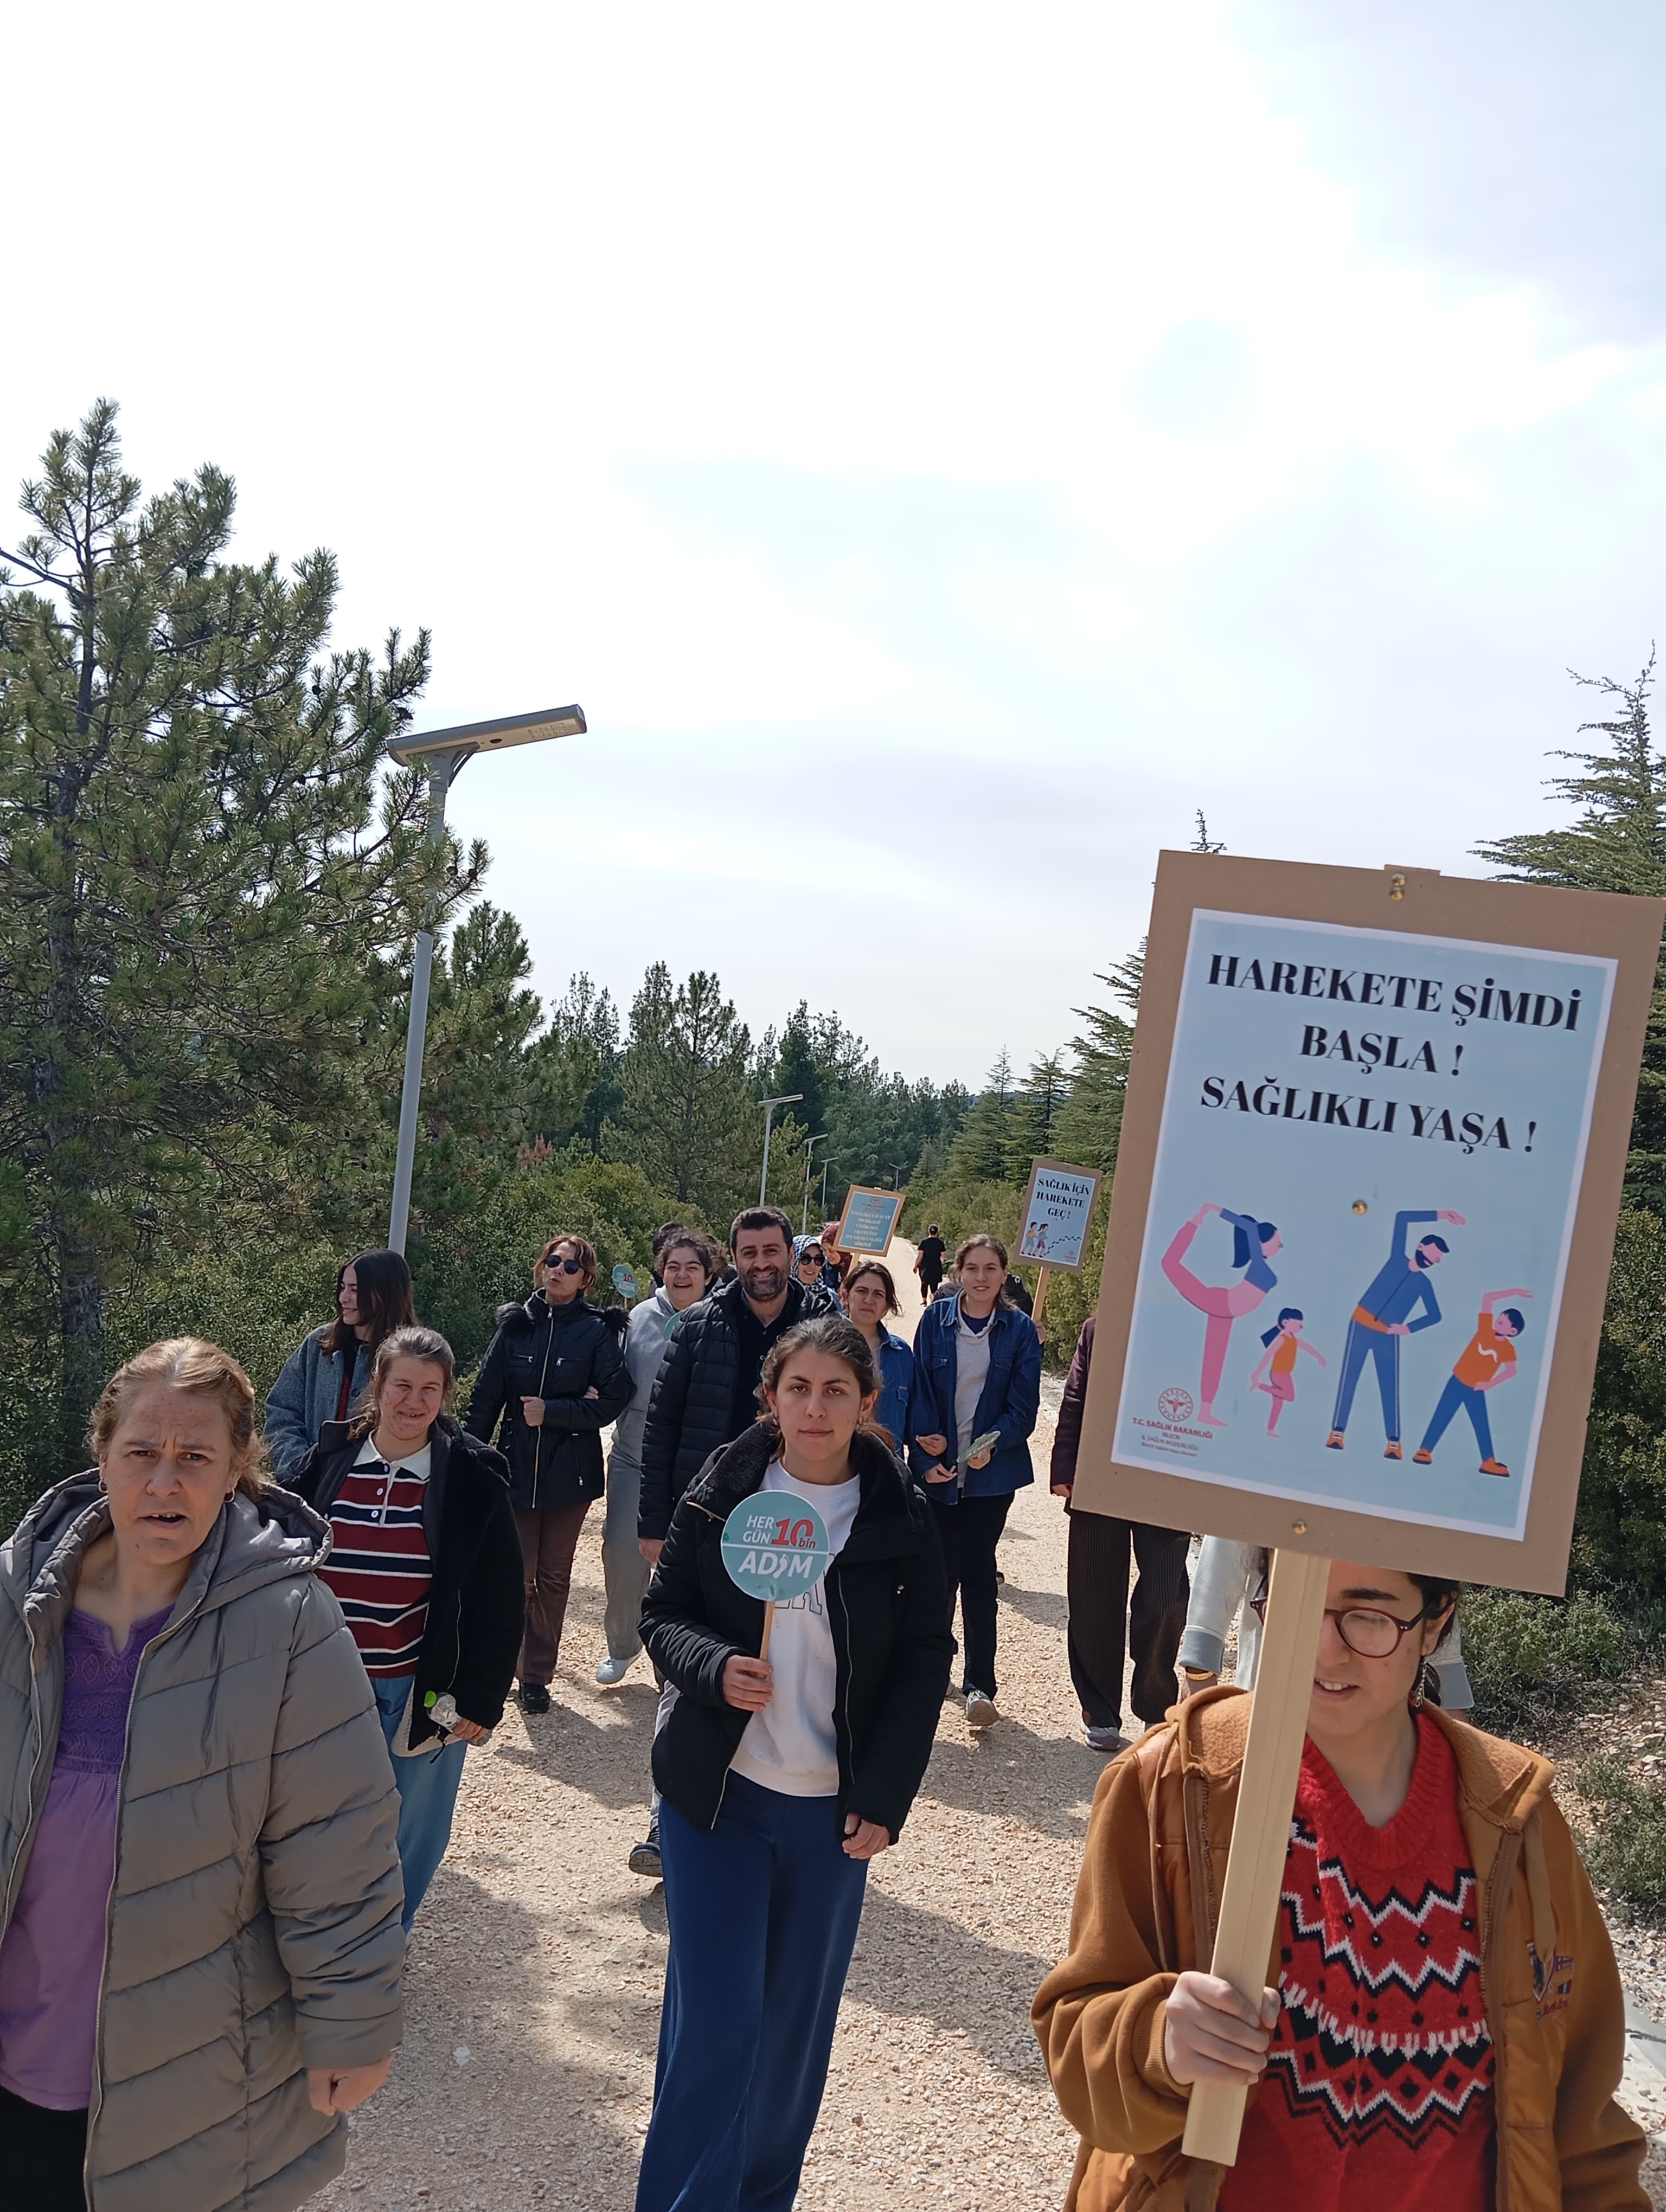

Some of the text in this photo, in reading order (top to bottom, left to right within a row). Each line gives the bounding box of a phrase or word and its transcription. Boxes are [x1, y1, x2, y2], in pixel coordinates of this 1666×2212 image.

[1207, 954, 1582, 1031] HAREKETE ŞİMDİ
[1299, 1024, 1464, 1077] BAŞLA !
[1201, 1076, 1537, 1155] SAĞLIKLI YAŞA !
[1037, 1178, 1090, 1195] SAĞLIK İÇİN
[1036, 1192, 1085, 1208] HAREKETE
[1048, 1207, 1071, 1220] GEÇ !
[1132, 1417, 1213, 1439] T.C. SAĞLIK BAKANLIĞI
[746, 1515, 775, 1529] HER
[742, 1529, 771, 1545] GÜN
[771, 1518, 816, 1549] 10 bin
[738, 1551, 813, 1579] ADIM
